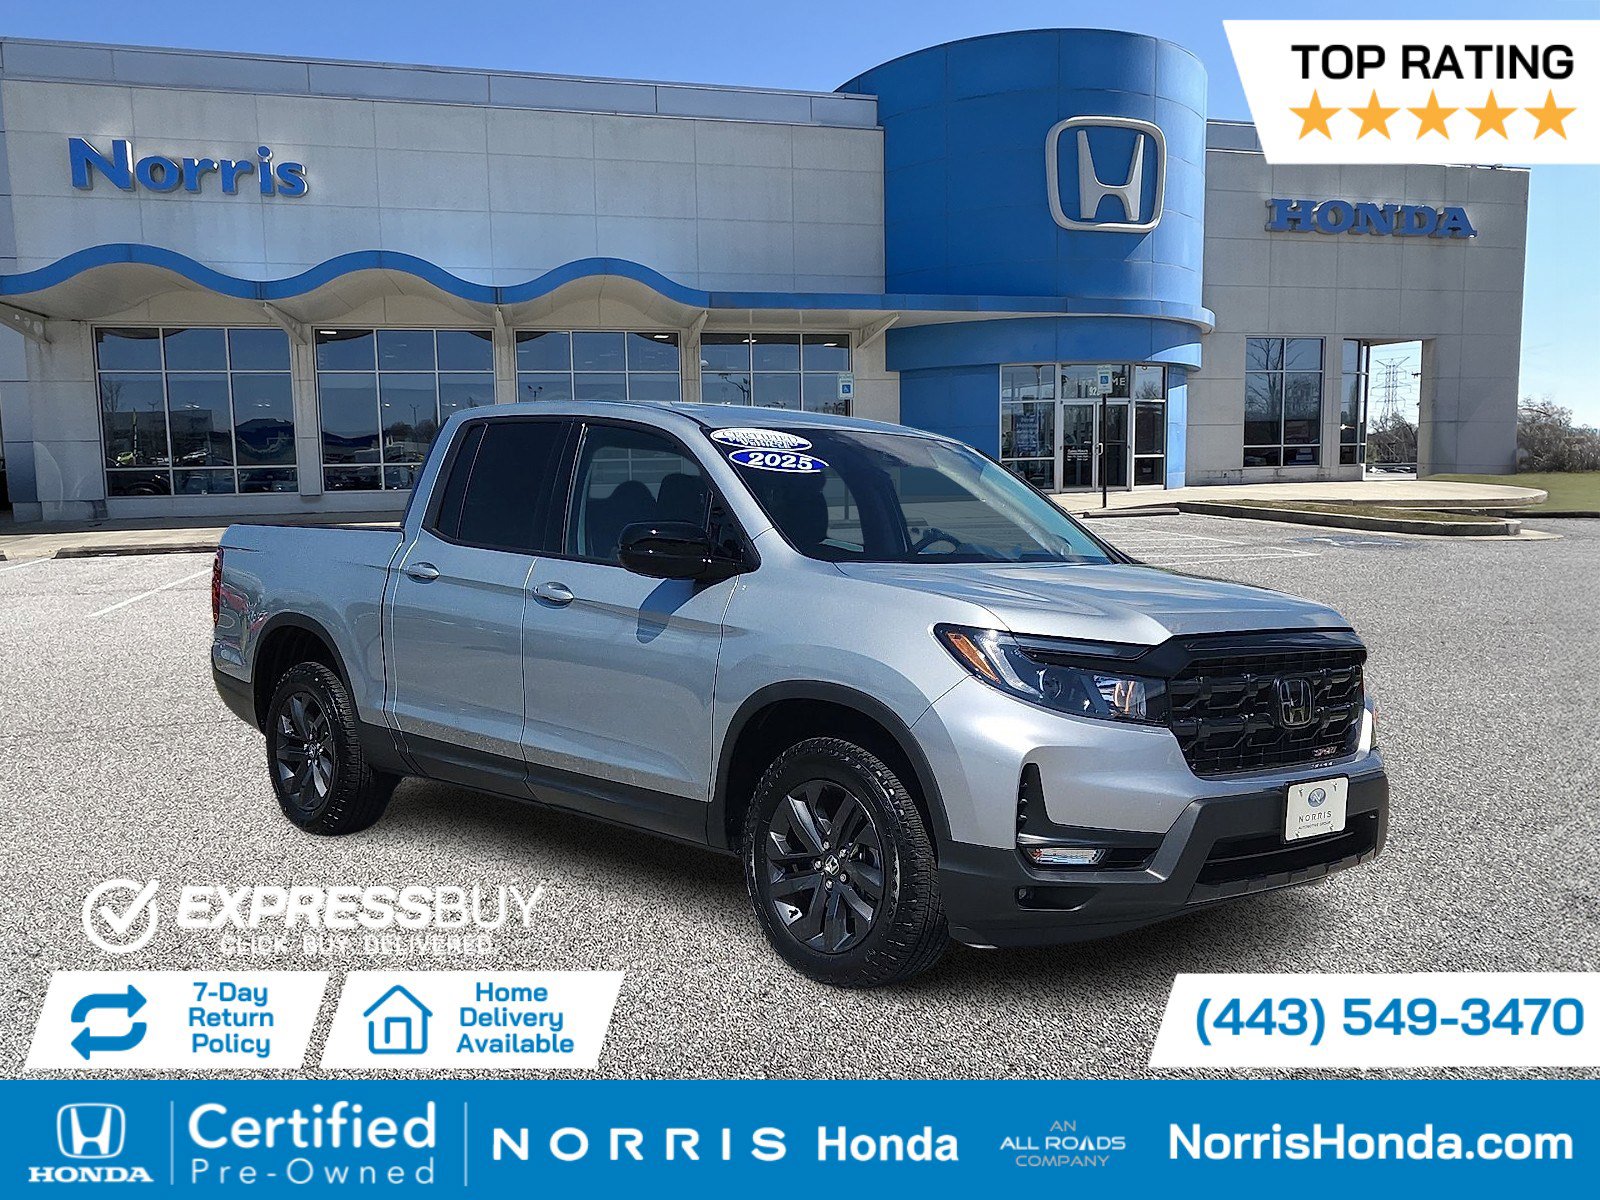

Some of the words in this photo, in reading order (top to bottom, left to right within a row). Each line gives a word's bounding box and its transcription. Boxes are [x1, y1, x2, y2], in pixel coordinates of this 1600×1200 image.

[68, 137, 308, 197] Norris
[1265, 198, 1478, 238] HONDA
[748, 452, 813, 470] 2025
[1298, 810, 1332, 823] NORRIS
